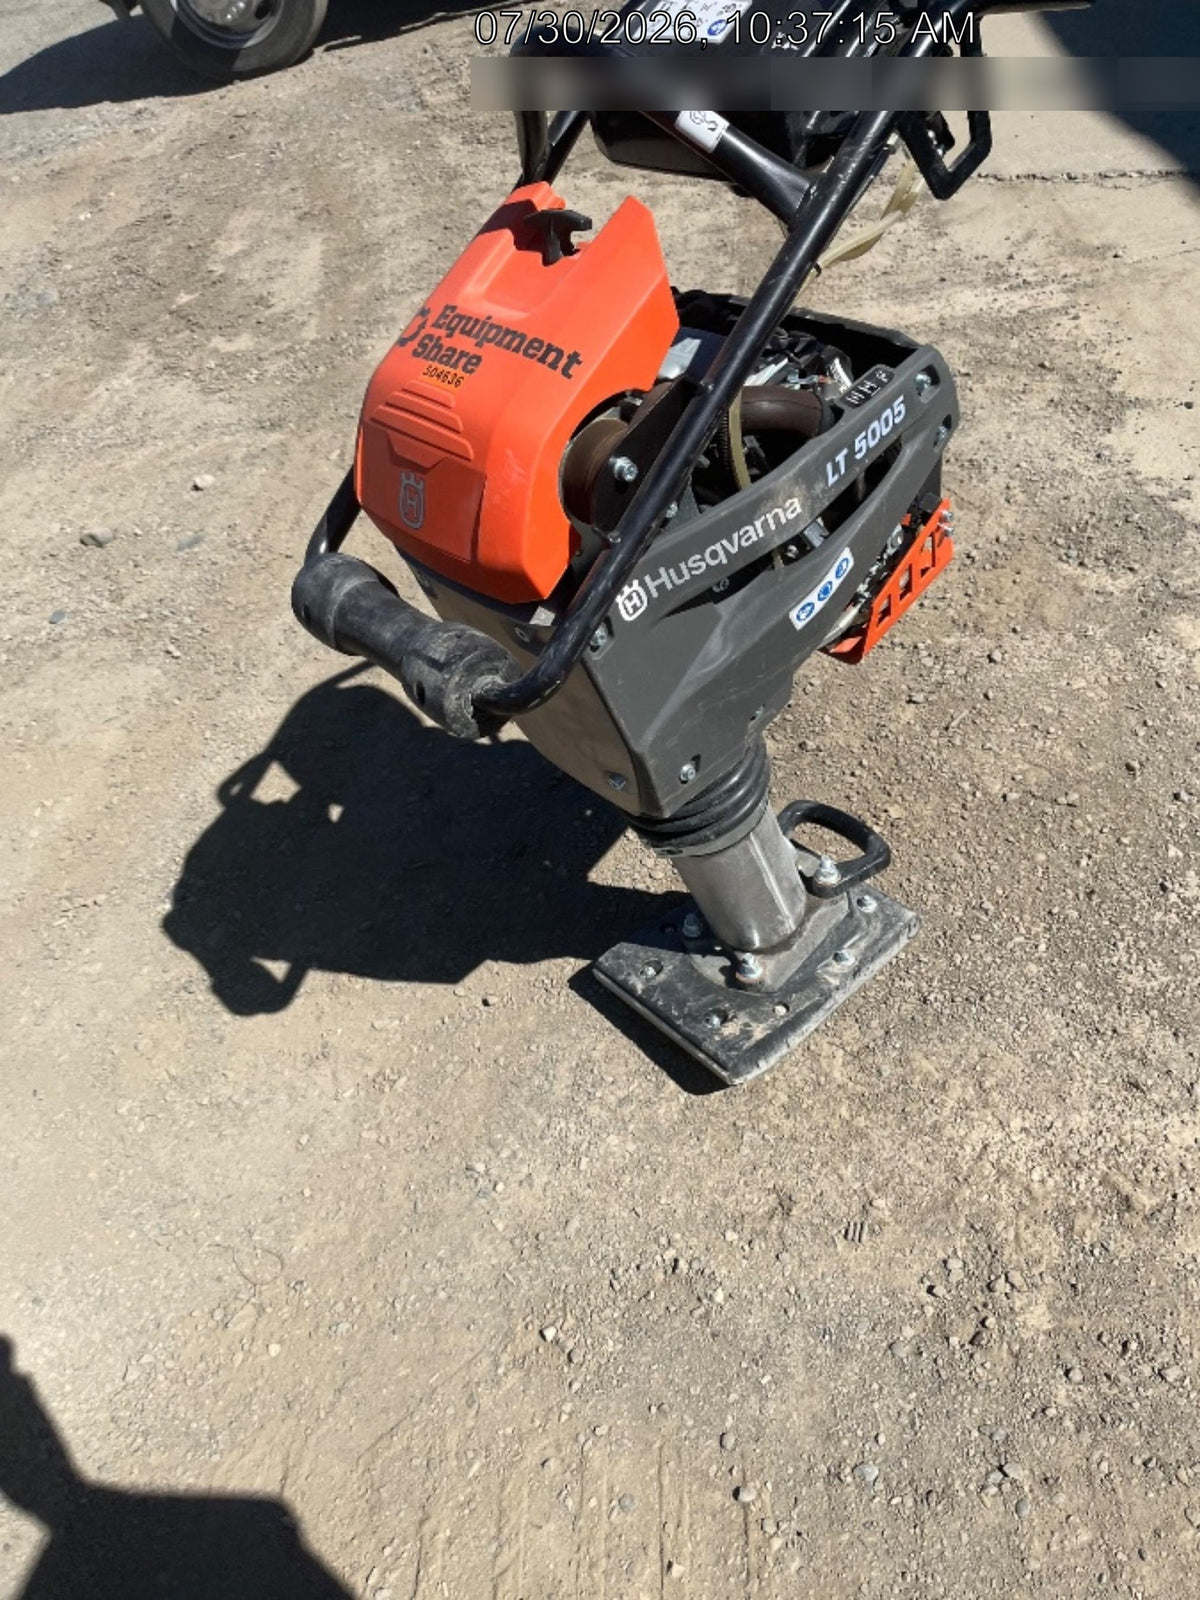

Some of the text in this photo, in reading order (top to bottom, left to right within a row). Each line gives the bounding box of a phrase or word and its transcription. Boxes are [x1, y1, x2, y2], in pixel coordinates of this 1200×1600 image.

[412, 335, 482, 374] share
[422, 364, 465, 388] 504636
[432, 304, 583, 379] Equipment
[825, 395, 906, 487] LT 5005
[646, 498, 803, 597] Husqvarna
